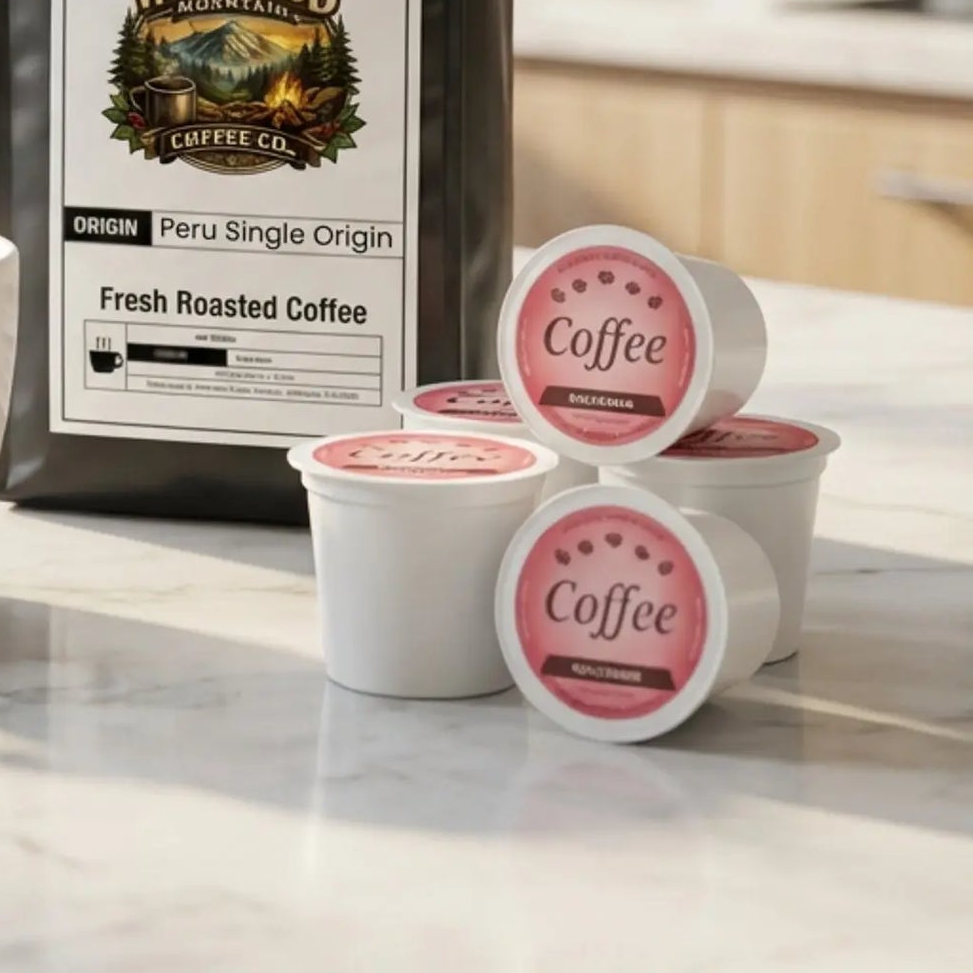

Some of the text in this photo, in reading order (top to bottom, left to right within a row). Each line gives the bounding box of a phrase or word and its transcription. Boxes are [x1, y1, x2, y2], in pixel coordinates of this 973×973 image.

[73, 215, 138, 237] ORIGIN
[160, 217, 393, 253] Peru Single Origin
[100, 286, 368, 325] Fresh Roasted Coffee
[543, 316, 668, 372] Coffee
[545, 579, 678, 641] Coffee
